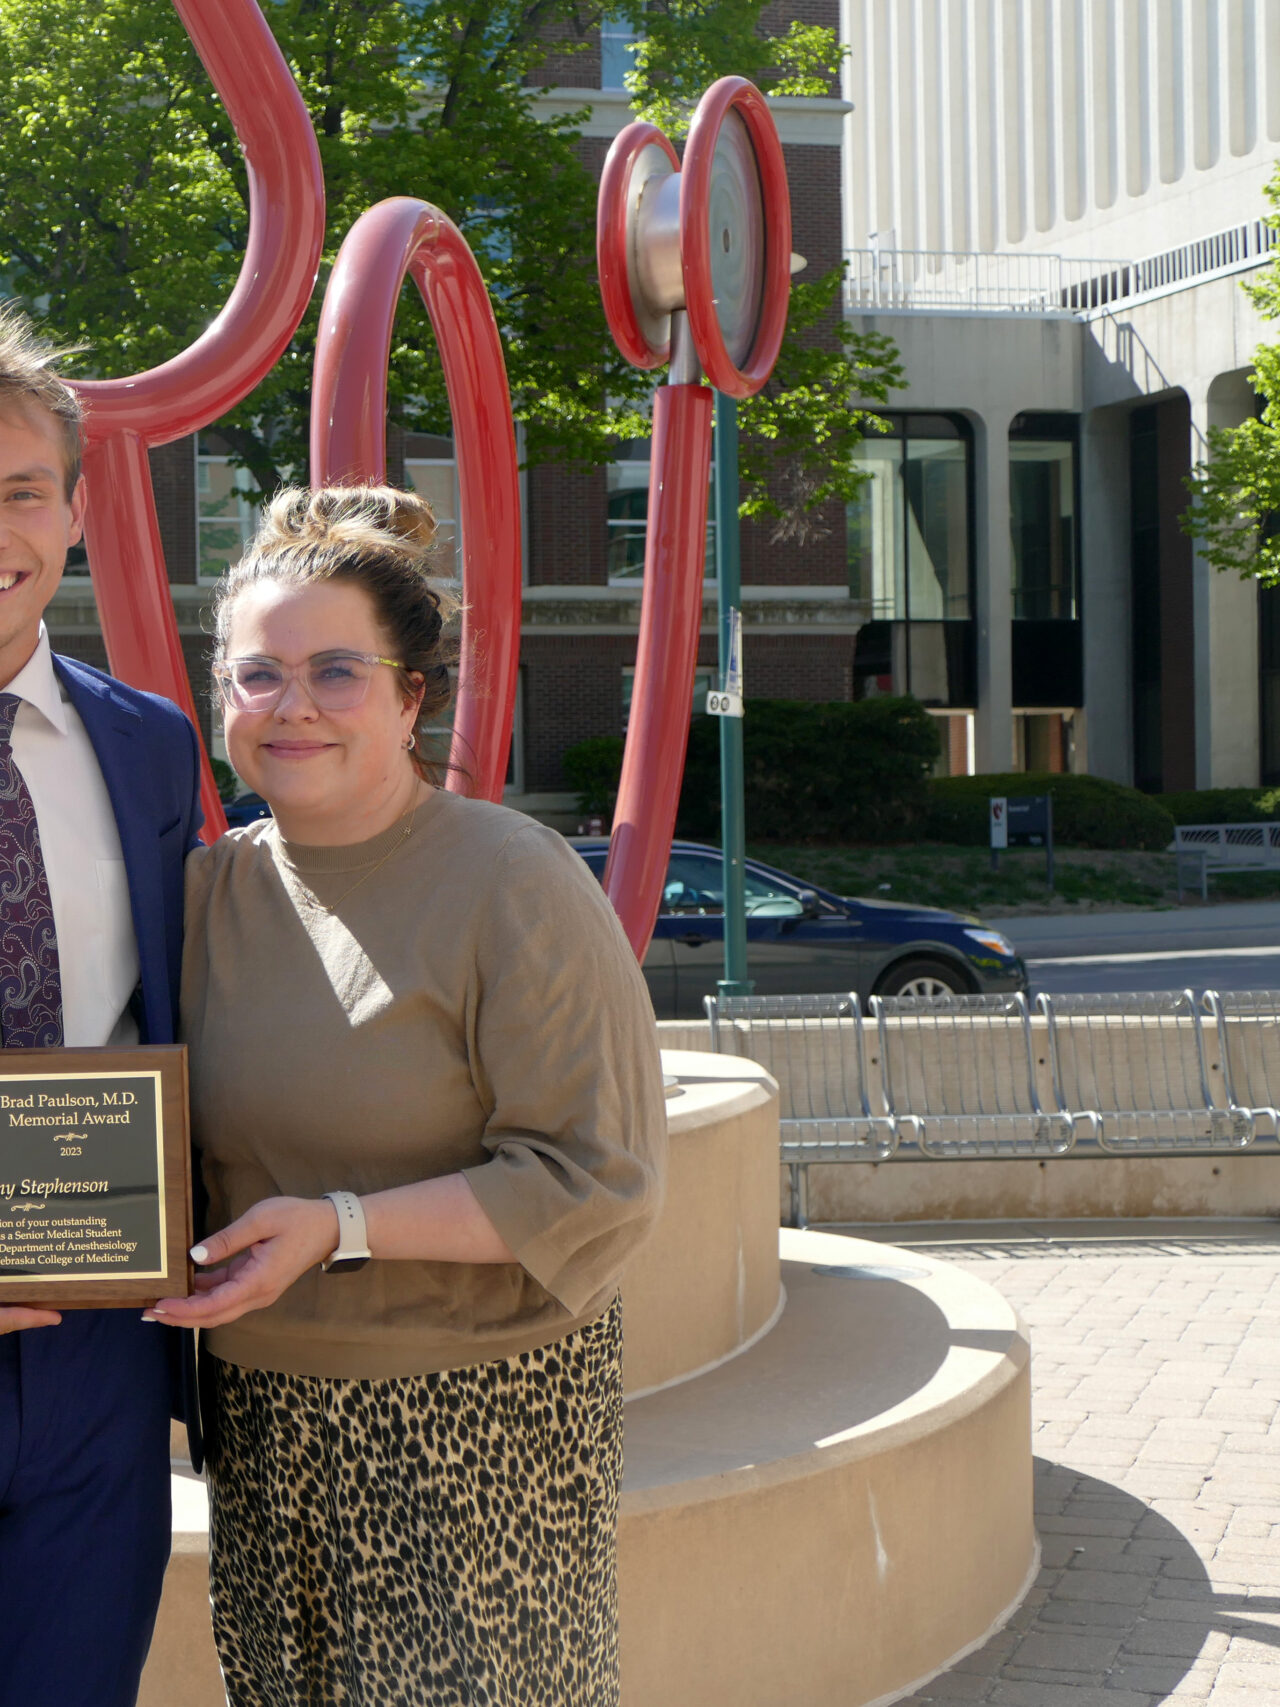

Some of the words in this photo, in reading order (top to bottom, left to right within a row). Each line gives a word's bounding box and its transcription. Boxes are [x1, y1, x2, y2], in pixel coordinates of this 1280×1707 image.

[0, 1094, 34, 1108] Brad
[38, 1093, 99, 1108] Paulson,
[102, 1092, 138, 1105] M.D.
[9, 1112, 78, 1127] Memorial
[82, 1110, 130, 1125] Award
[60, 1147, 82, 1156] 2023
[20, 1178, 109, 1199] Stephenson
[16, 1218, 26, 1228] of
[28, 1219, 49, 1230] your
[51, 1216, 107, 1227] outstanding
[15, 1230, 45, 1240] Senior
[47, 1229, 83, 1239] Medical
[85, 1228, 122, 1237] Student
[55, 1242, 65, 1252] of
[67, 1240, 138, 1252] Anesthesiology
[37, 1254, 72, 1266] College
[74, 1254, 84, 1263] of
[86, 1253, 129, 1263] Medicine
